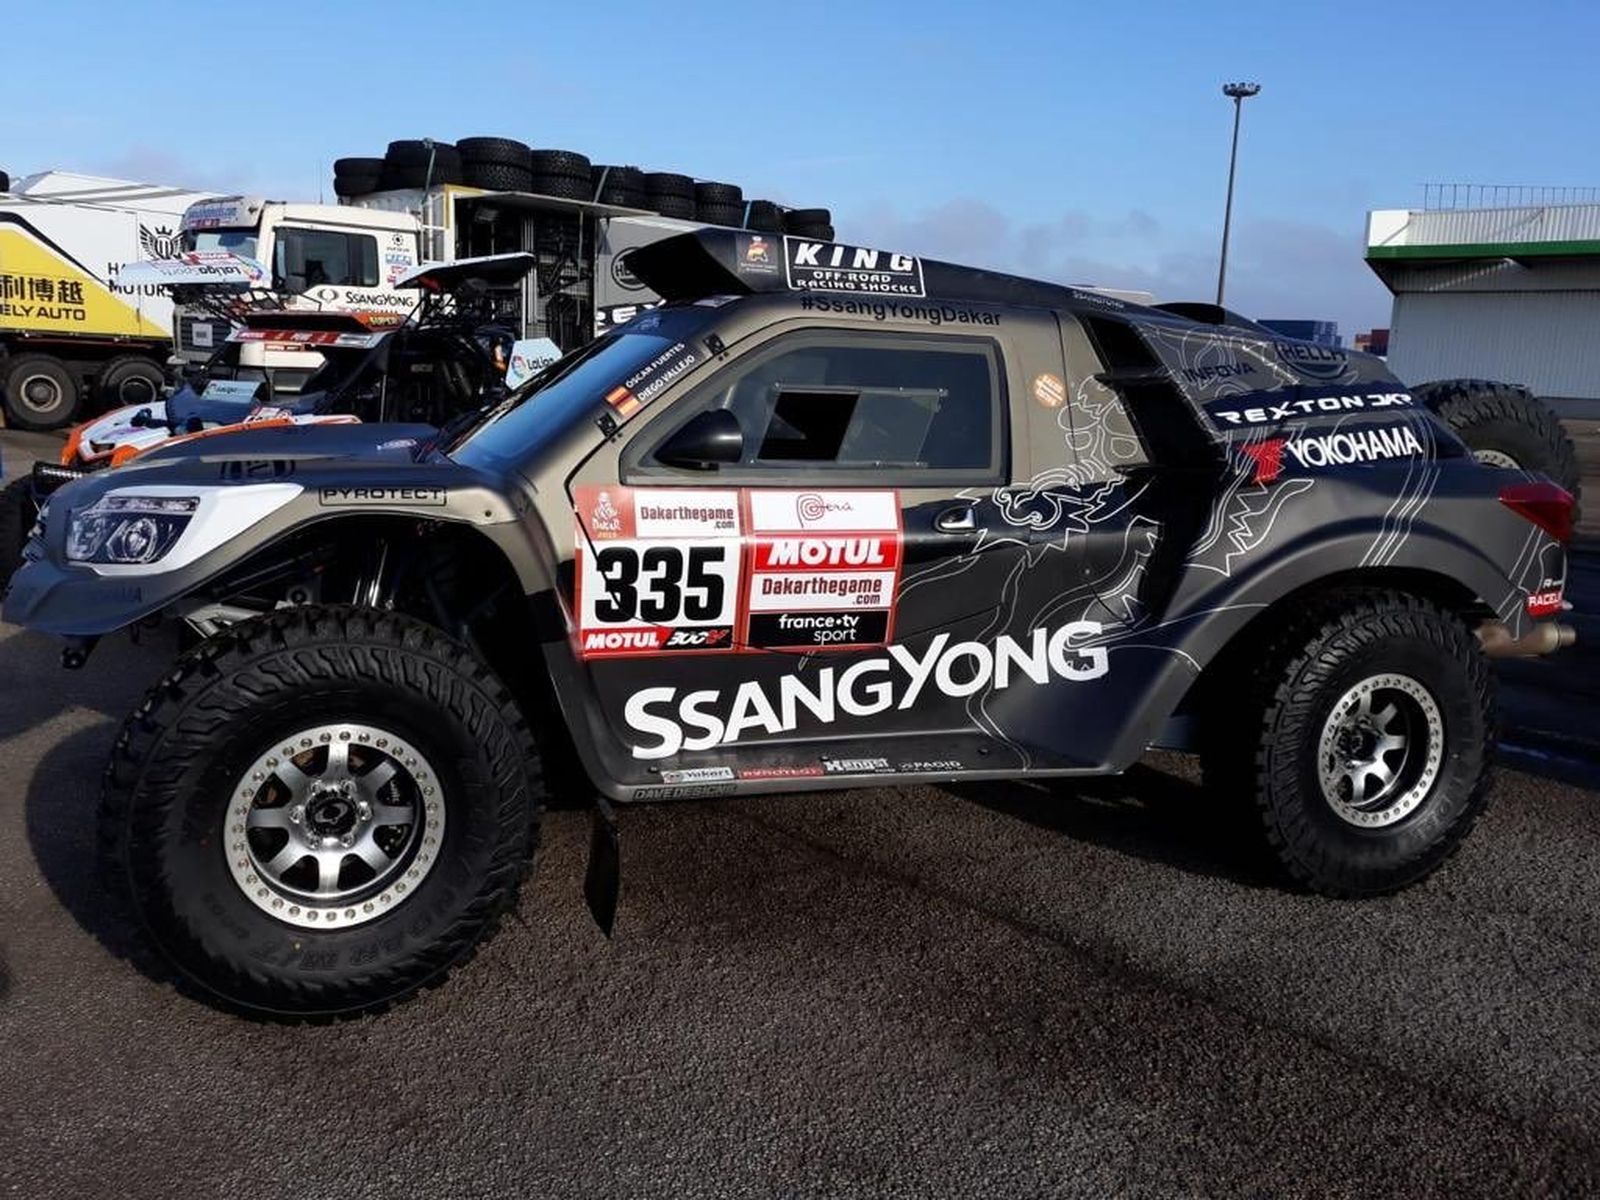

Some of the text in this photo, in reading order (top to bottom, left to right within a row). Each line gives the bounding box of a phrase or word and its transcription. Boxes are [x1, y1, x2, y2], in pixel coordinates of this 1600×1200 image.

[795, 242, 913, 271] KING
[796, 279, 917, 294] RACING SHOCKS
[813, 271, 891, 283] OFF-ROAD
[37, 307, 86, 321] AUTO
[801, 293, 1001, 326] #SsangYongDakar
[637, 354, 696, 402] DIEGO VALLEJO
[1214, 397, 1364, 424] REXTON
[1287, 426, 1423, 468] YOKOHAMA
[323, 488, 445, 500] PYROTECT
[641, 506, 734, 522] Dakarthegame
[714, 520, 735, 529] .com
[768, 538, 885, 566] MOTUL
[594, 546, 725, 623] 335
[762, 577, 882, 597] Dakarthegame
[852, 594, 881, 606] .com
[585, 631, 660, 651] MOTUL
[814, 628, 857, 645] sport
[624, 620, 1110, 760] SSANGYONG
